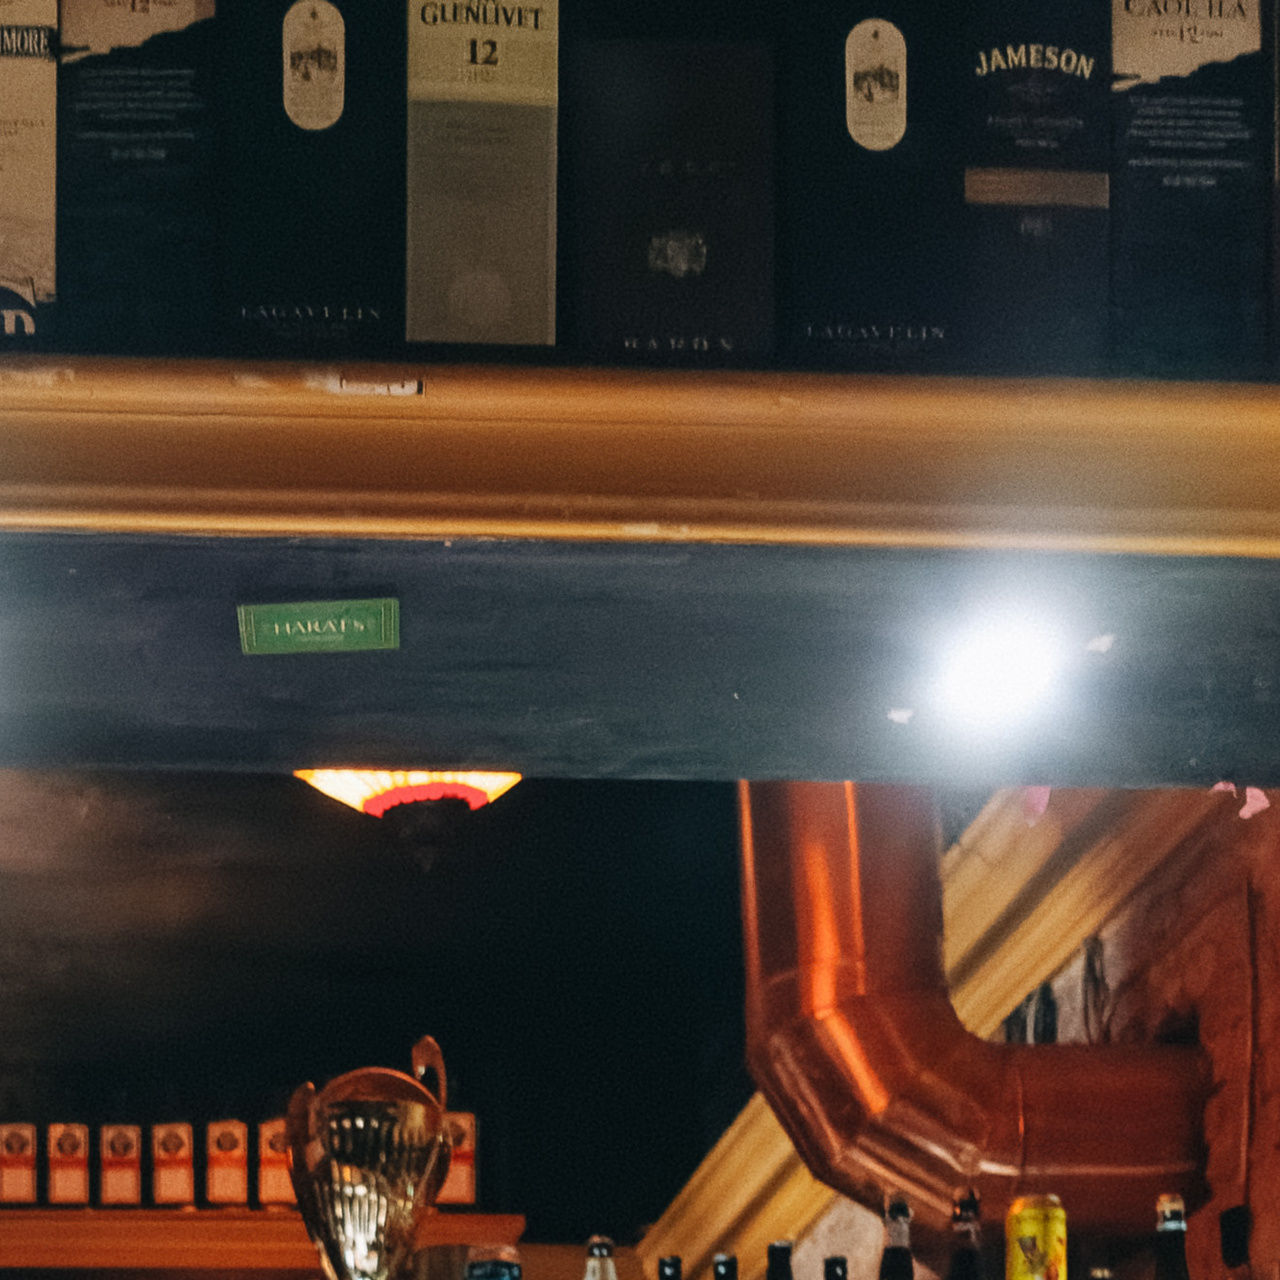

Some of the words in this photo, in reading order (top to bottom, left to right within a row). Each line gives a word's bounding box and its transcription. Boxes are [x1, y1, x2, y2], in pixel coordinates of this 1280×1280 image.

[420, 3, 542, 31] GLENLIVET
[468, 38, 498, 66] 12
[973, 43, 1095, 81] JAMESON
